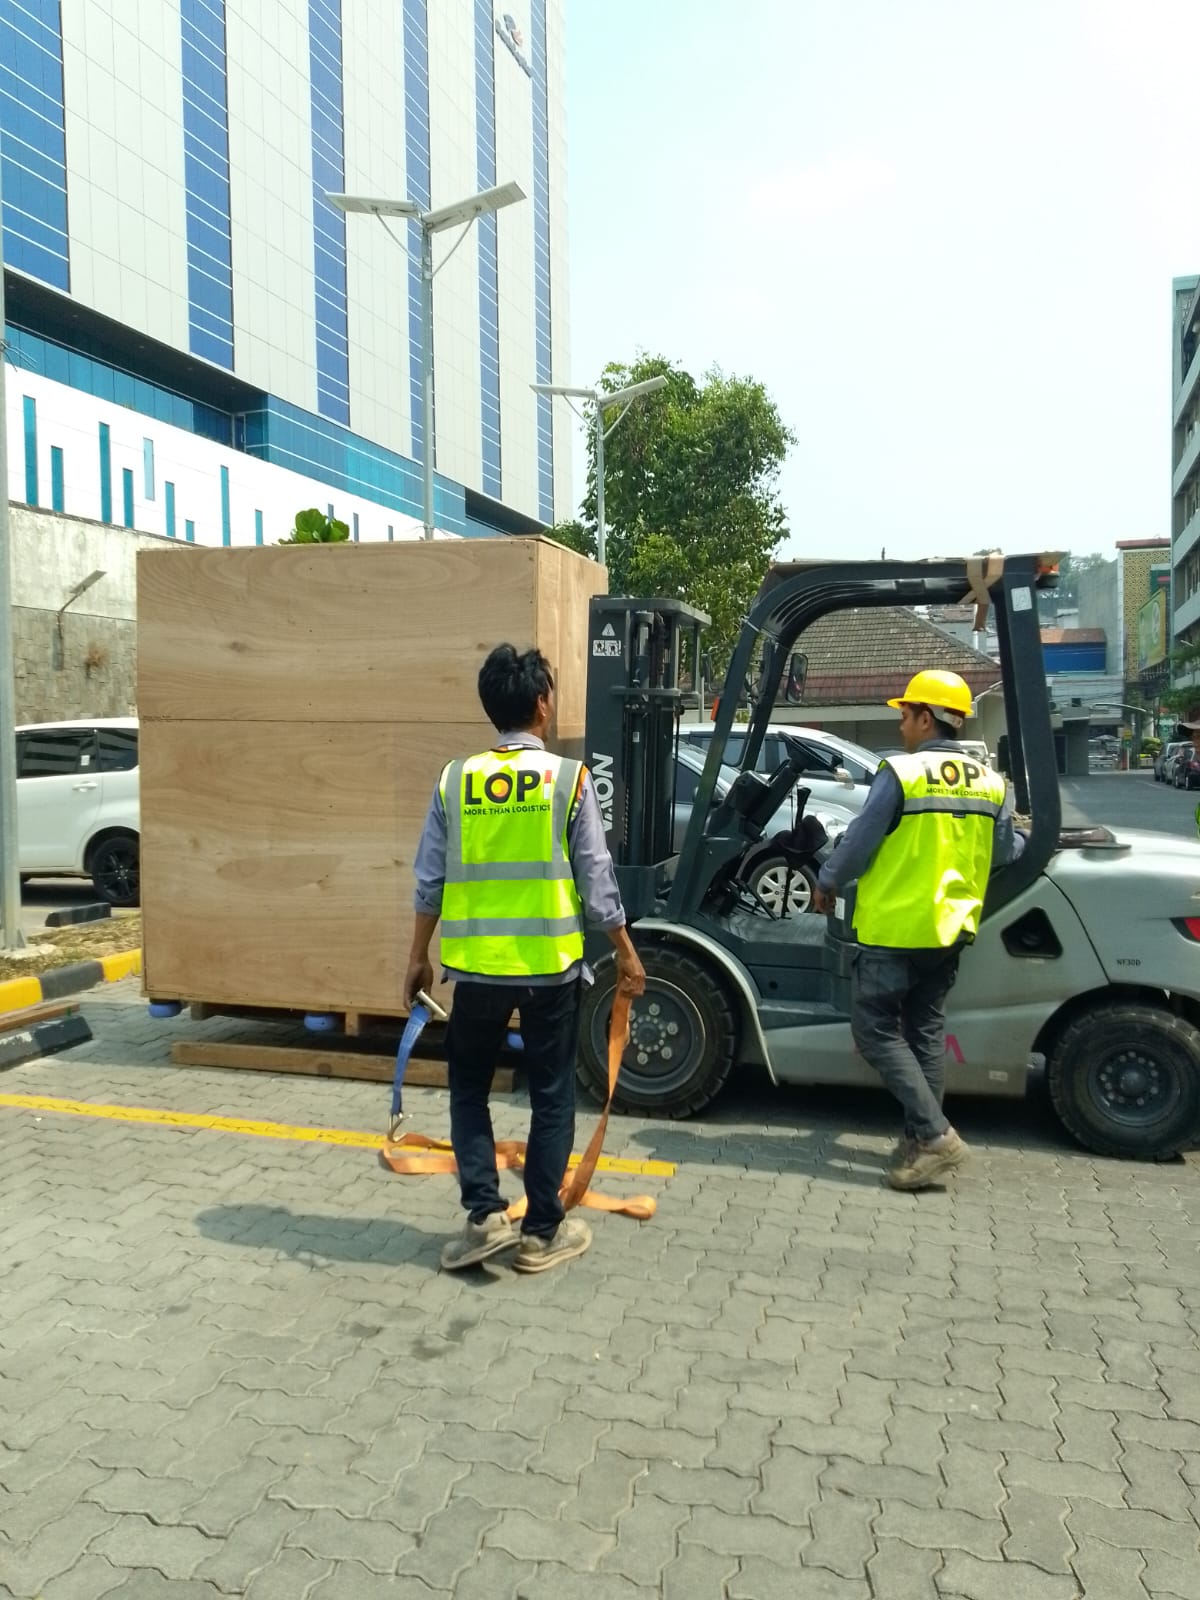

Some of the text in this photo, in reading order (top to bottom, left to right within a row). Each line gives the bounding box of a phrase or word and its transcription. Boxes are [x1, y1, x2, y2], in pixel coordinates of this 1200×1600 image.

[464, 804, 551, 816] MORE THAN LOGISTICS
